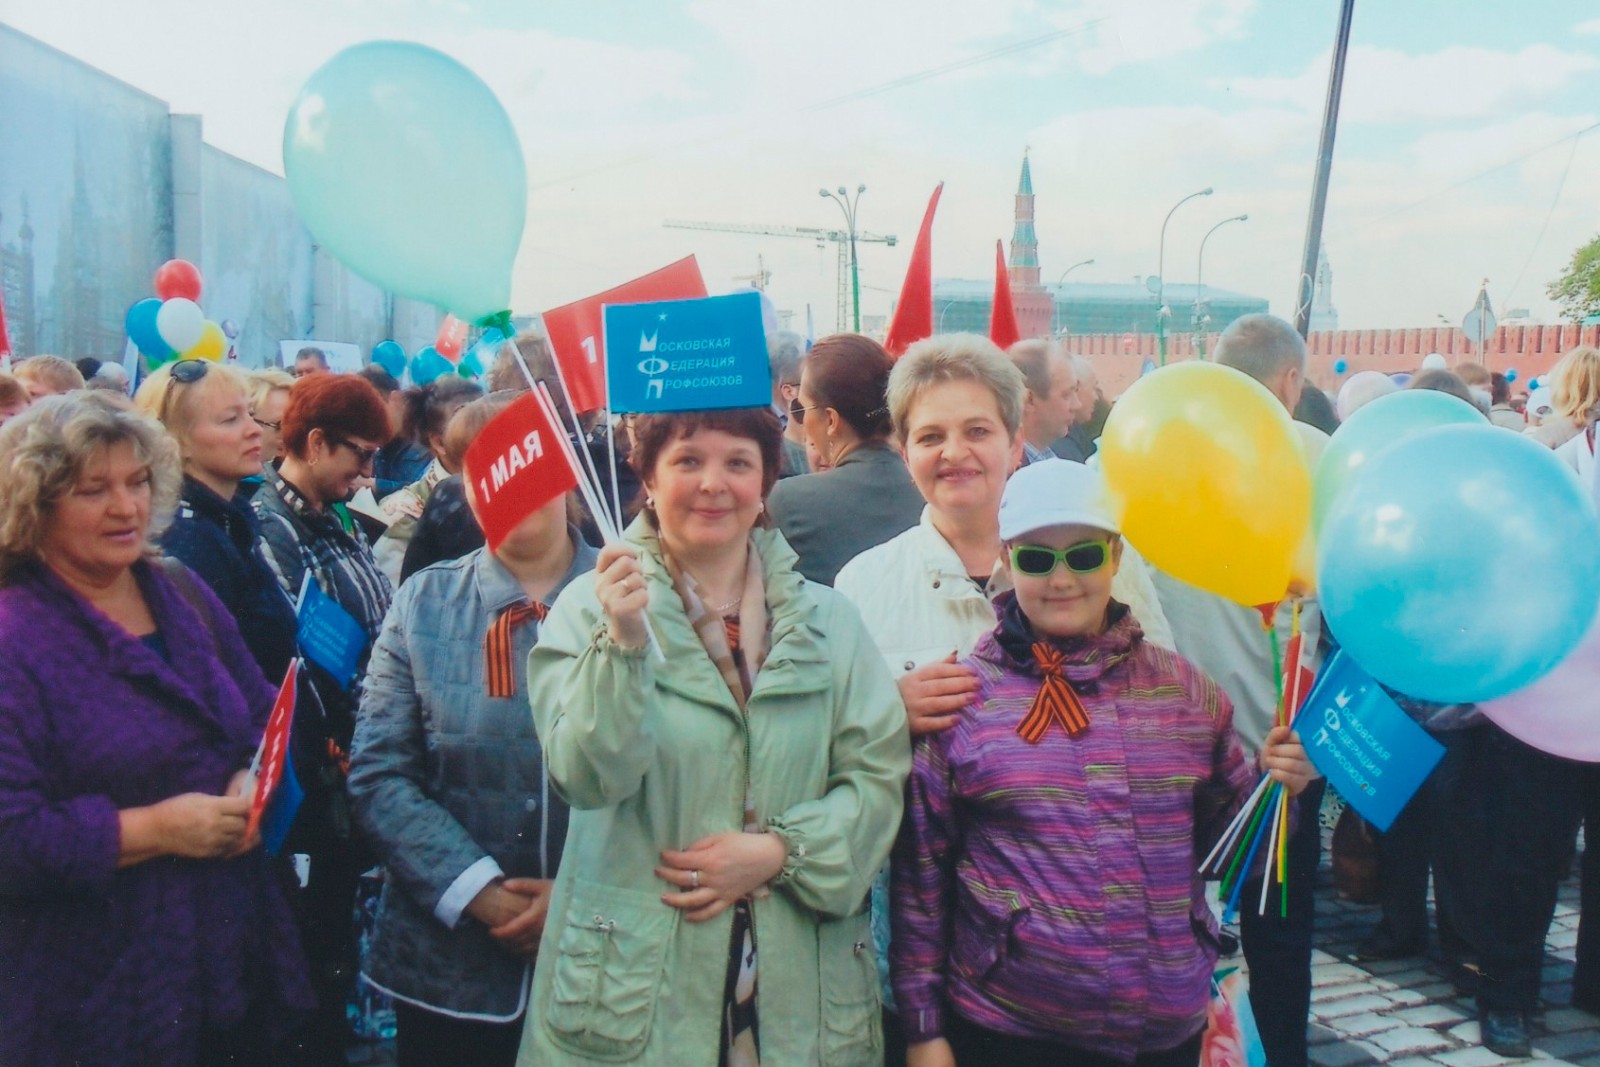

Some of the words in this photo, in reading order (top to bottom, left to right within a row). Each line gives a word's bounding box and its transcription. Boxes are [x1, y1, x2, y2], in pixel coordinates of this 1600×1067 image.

[580, 335, 598, 364] 1
[639, 328, 731, 352] МОСКОВСКАЯ
[637, 354, 736, 378] ФЕДЕРАЦИЯ
[645, 375, 743, 400] ПРОФСОЮЗОВ
[480, 476, 491, 504] 1
[490, 429, 544, 493] МАЯ
